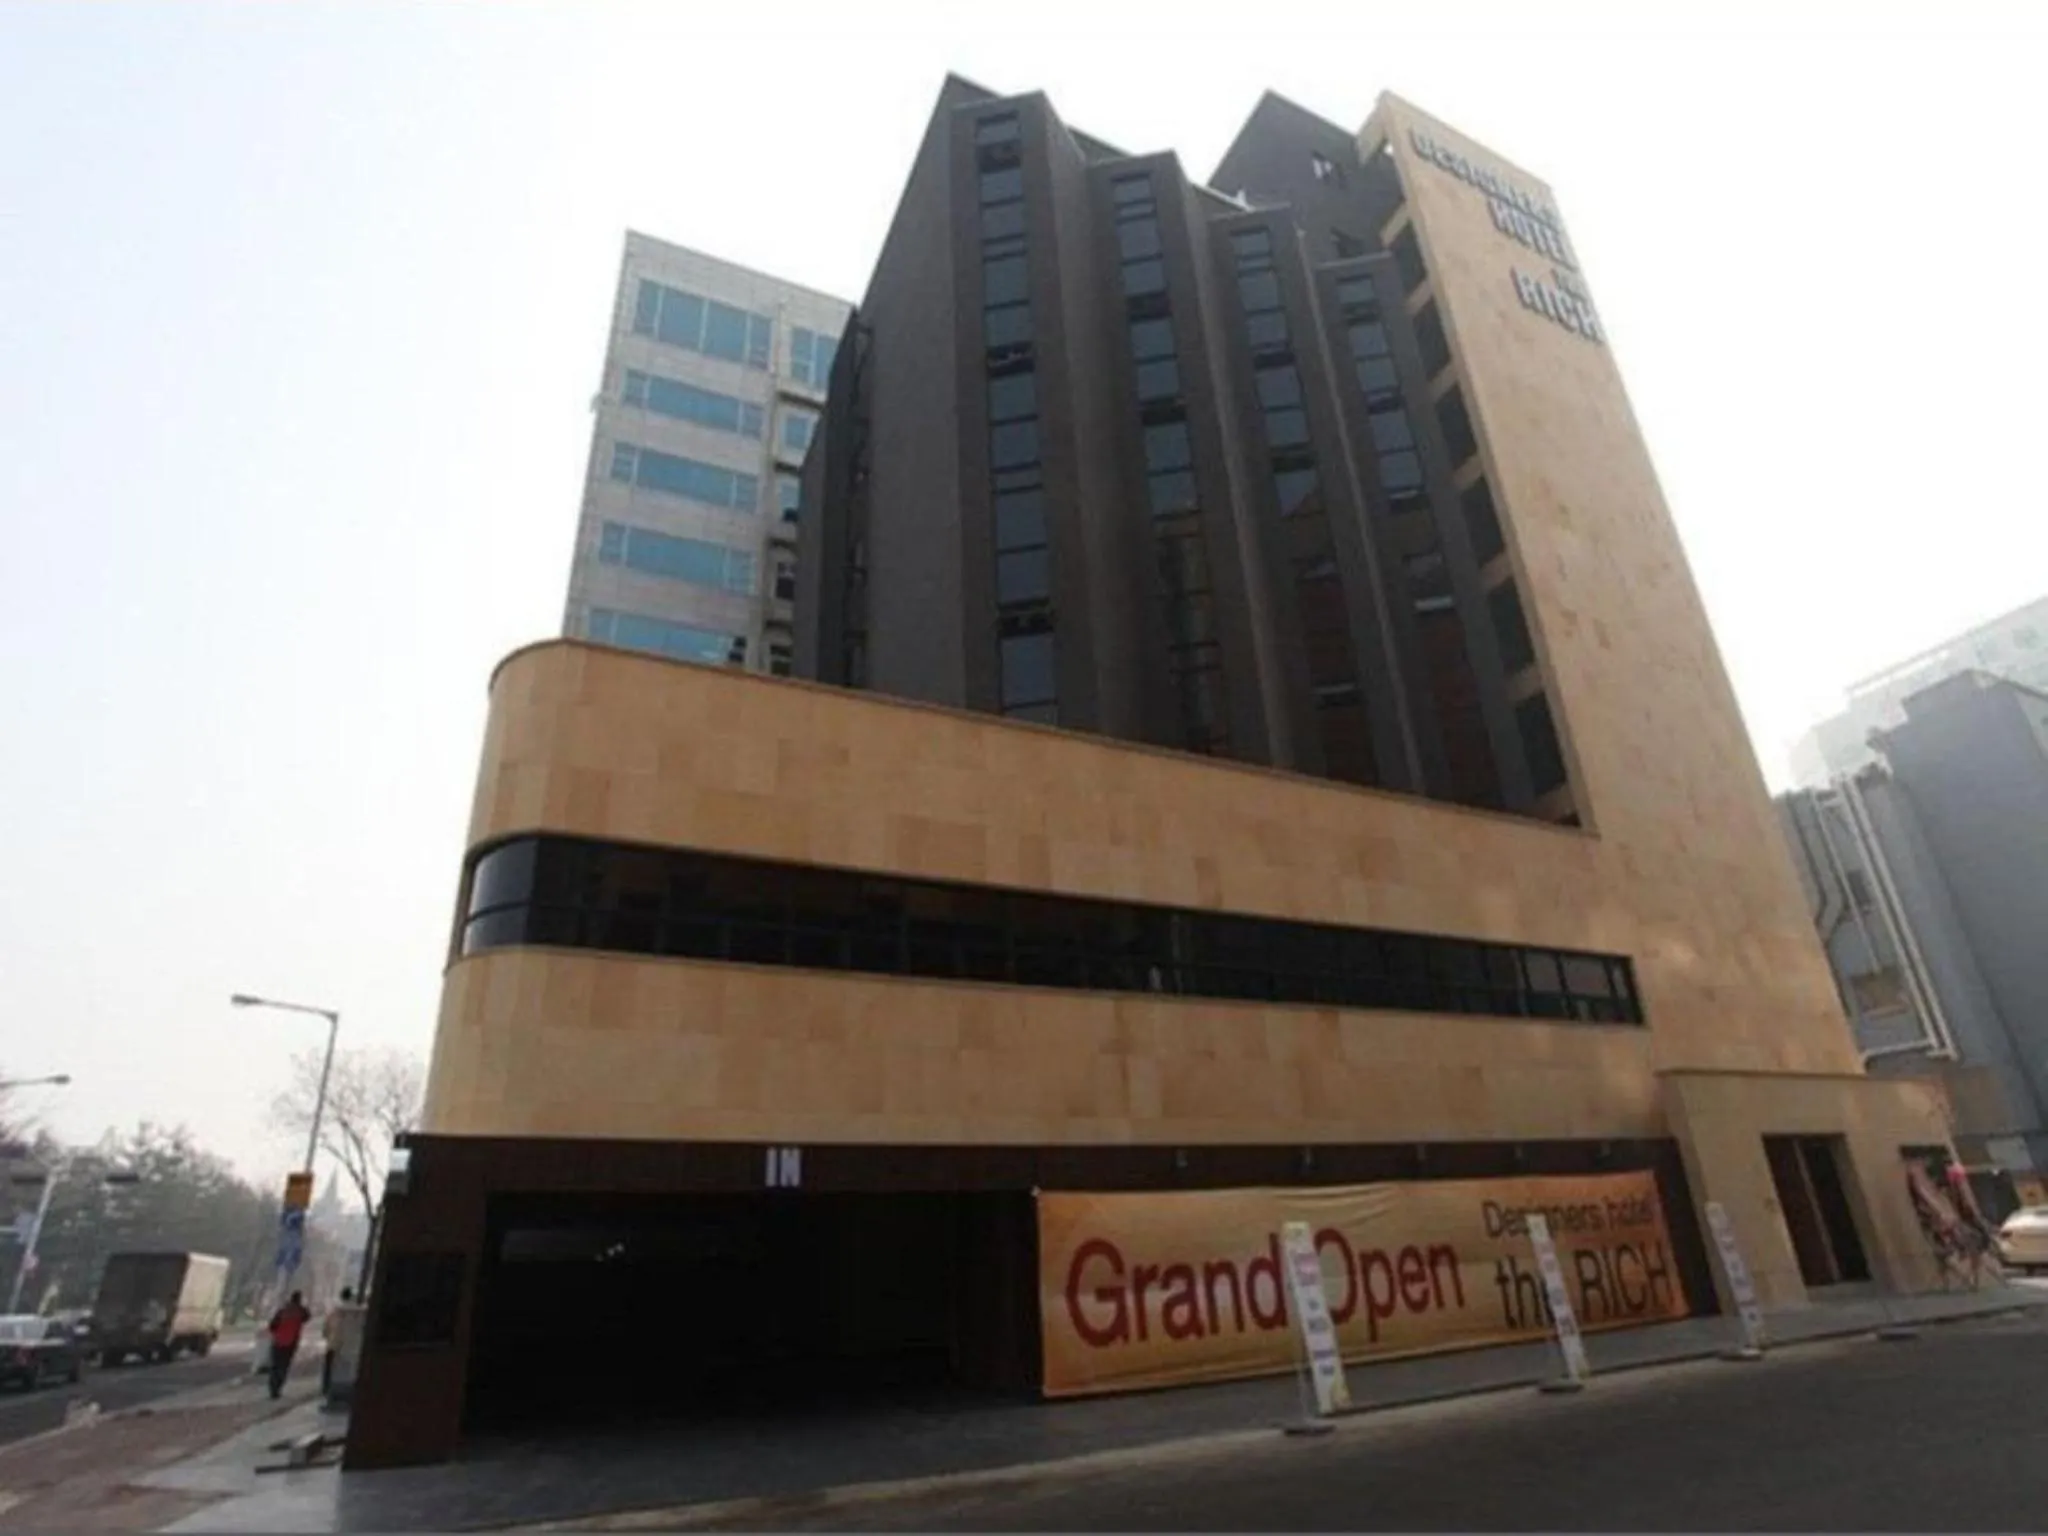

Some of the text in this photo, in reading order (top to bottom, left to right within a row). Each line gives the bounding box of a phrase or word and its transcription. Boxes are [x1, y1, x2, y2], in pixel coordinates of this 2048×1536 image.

[1511, 266, 1605, 345] RICH
[765, 1147, 800, 1187] IN
[1066, 1233, 1288, 1348] Grand
[1312, 1228, 1464, 1341] Open
[1573, 1241, 1676, 1322] RICH
